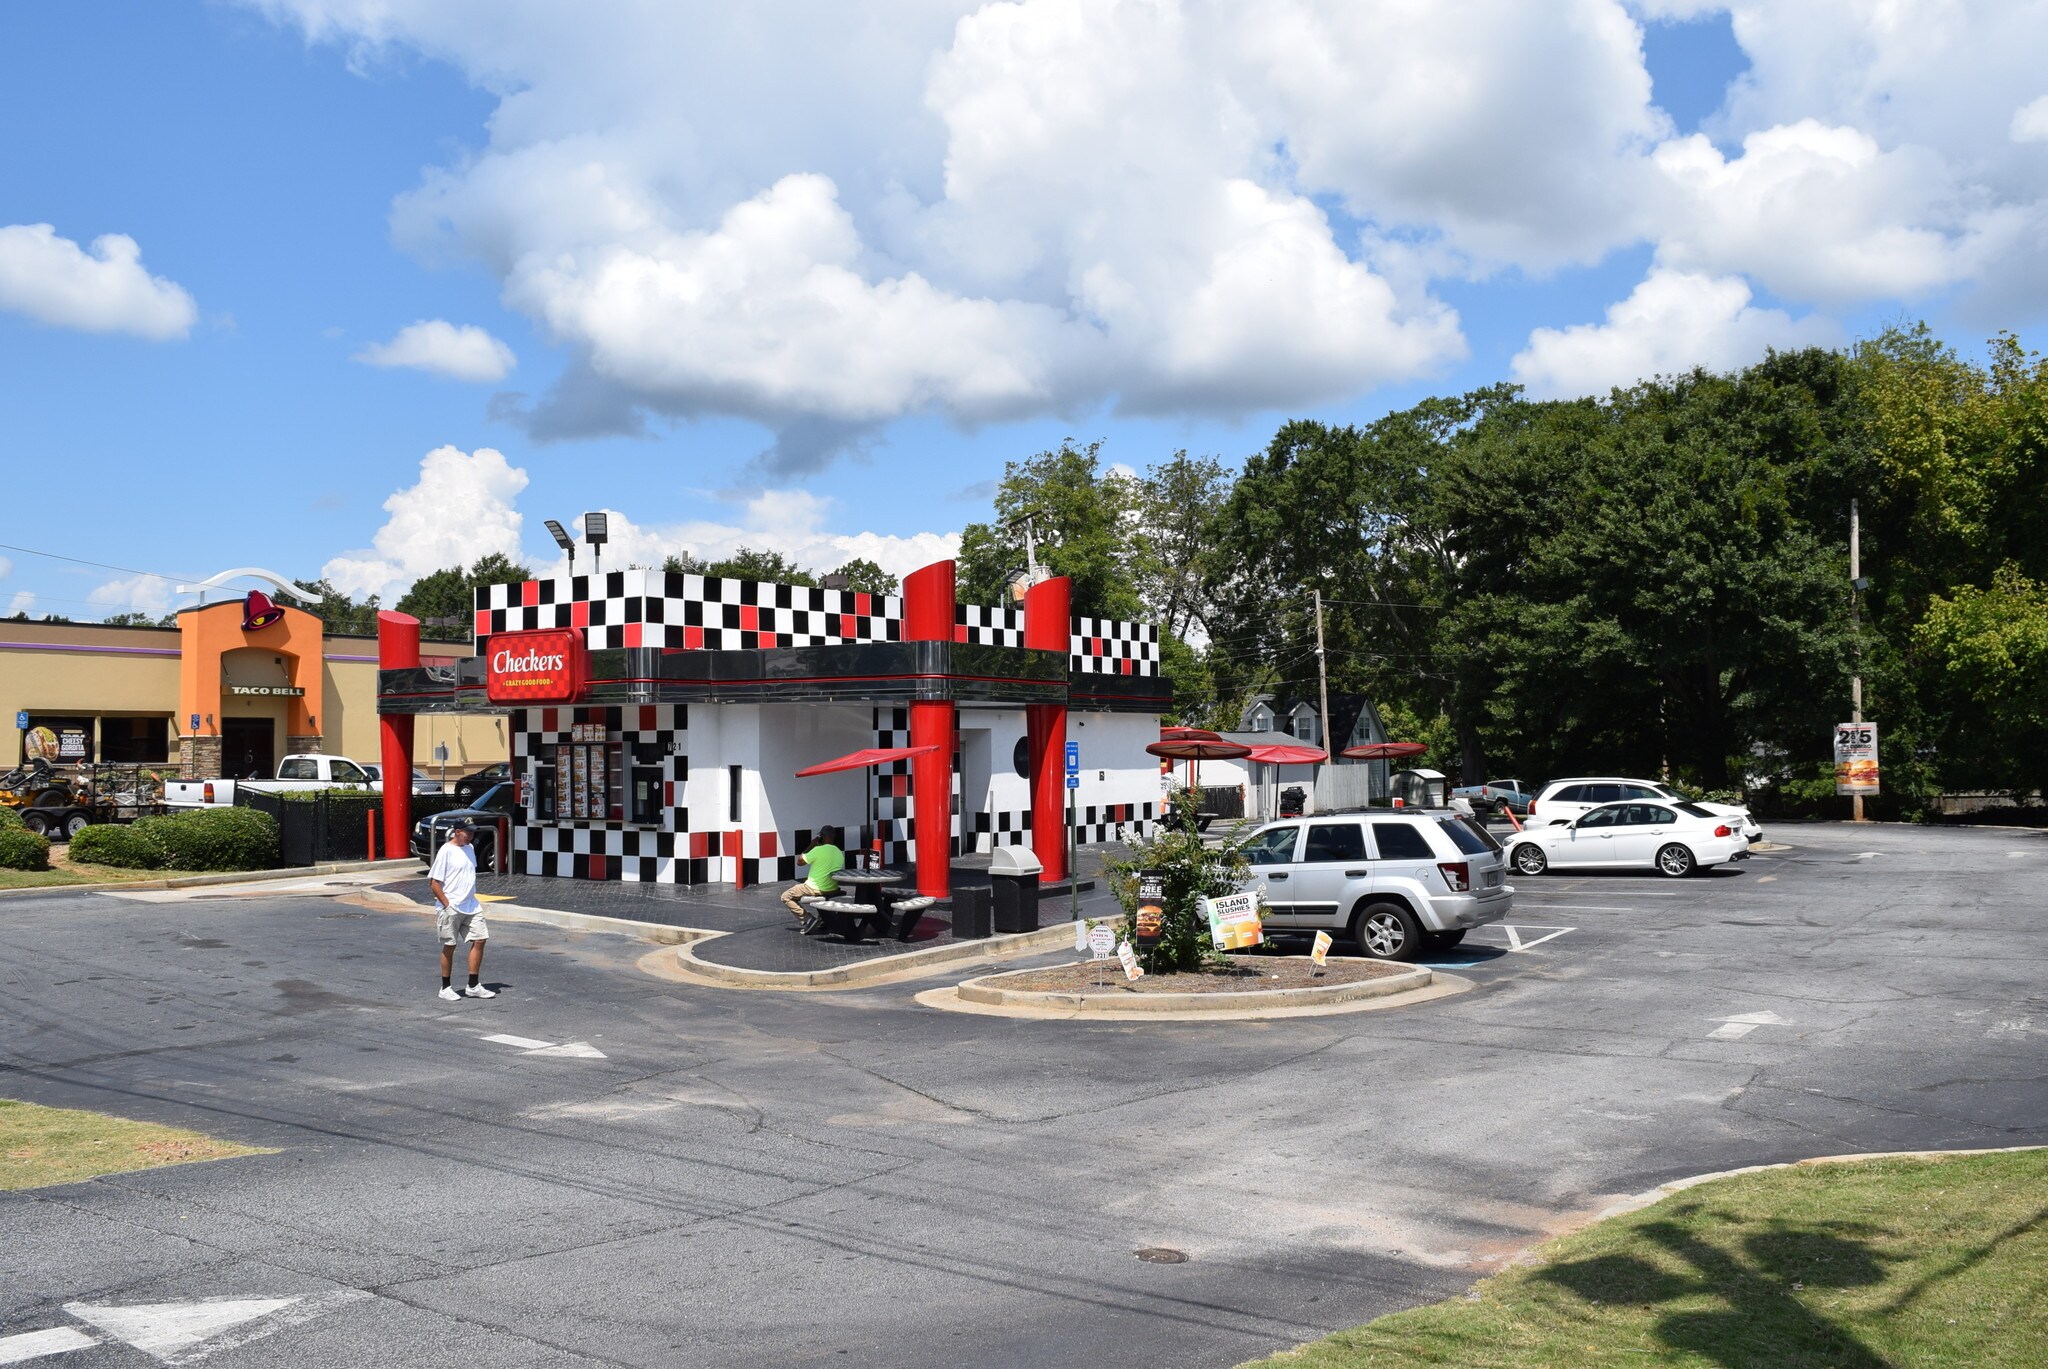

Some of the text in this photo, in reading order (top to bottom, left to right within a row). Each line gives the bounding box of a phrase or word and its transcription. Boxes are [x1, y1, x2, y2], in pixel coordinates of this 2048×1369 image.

[493, 648, 563, 674] Checkers
[231, 686, 303, 696] TACO BELL
[1839, 730, 1850, 744] 2
[667, 742, 681, 751] 721
[1140, 885, 1162, 893] FREE
[1216, 897, 1249, 909] ISLAND
[1217, 904, 1251, 915] SLUSHIES
